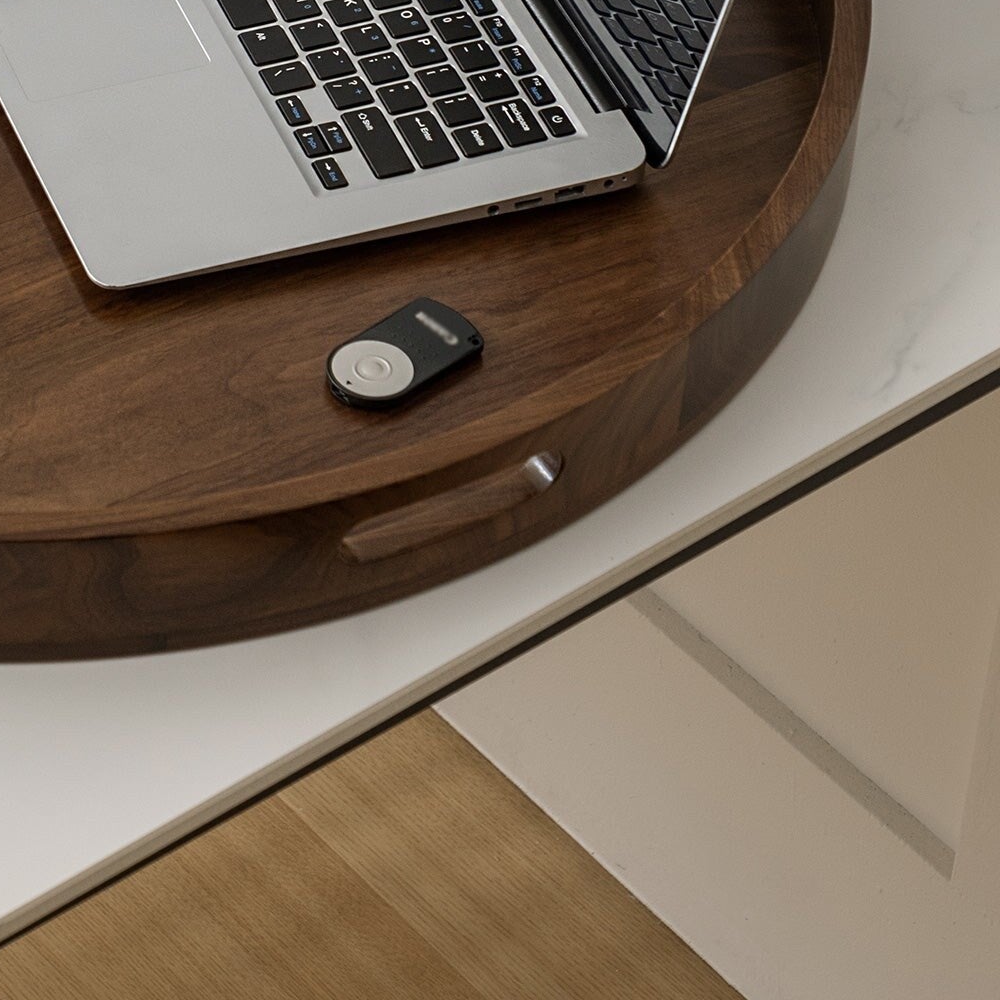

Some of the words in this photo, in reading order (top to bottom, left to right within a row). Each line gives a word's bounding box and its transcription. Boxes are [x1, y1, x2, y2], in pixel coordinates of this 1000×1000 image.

[400, 10, 414, 19] O
[492, 17, 503, 28] F10
[360, 25, 373, 34] L
[255, 32, 267, 41] Alt
[417, 38, 431, 46] P
[511, 47, 522, 57] F11
[532, 77, 542, 87] F12
[508, 102, 530, 132] Backspace
[363, 119, 374, 131] Shift
[420, 127, 433, 141] Enter
[470, 129, 485, 147] Delete
